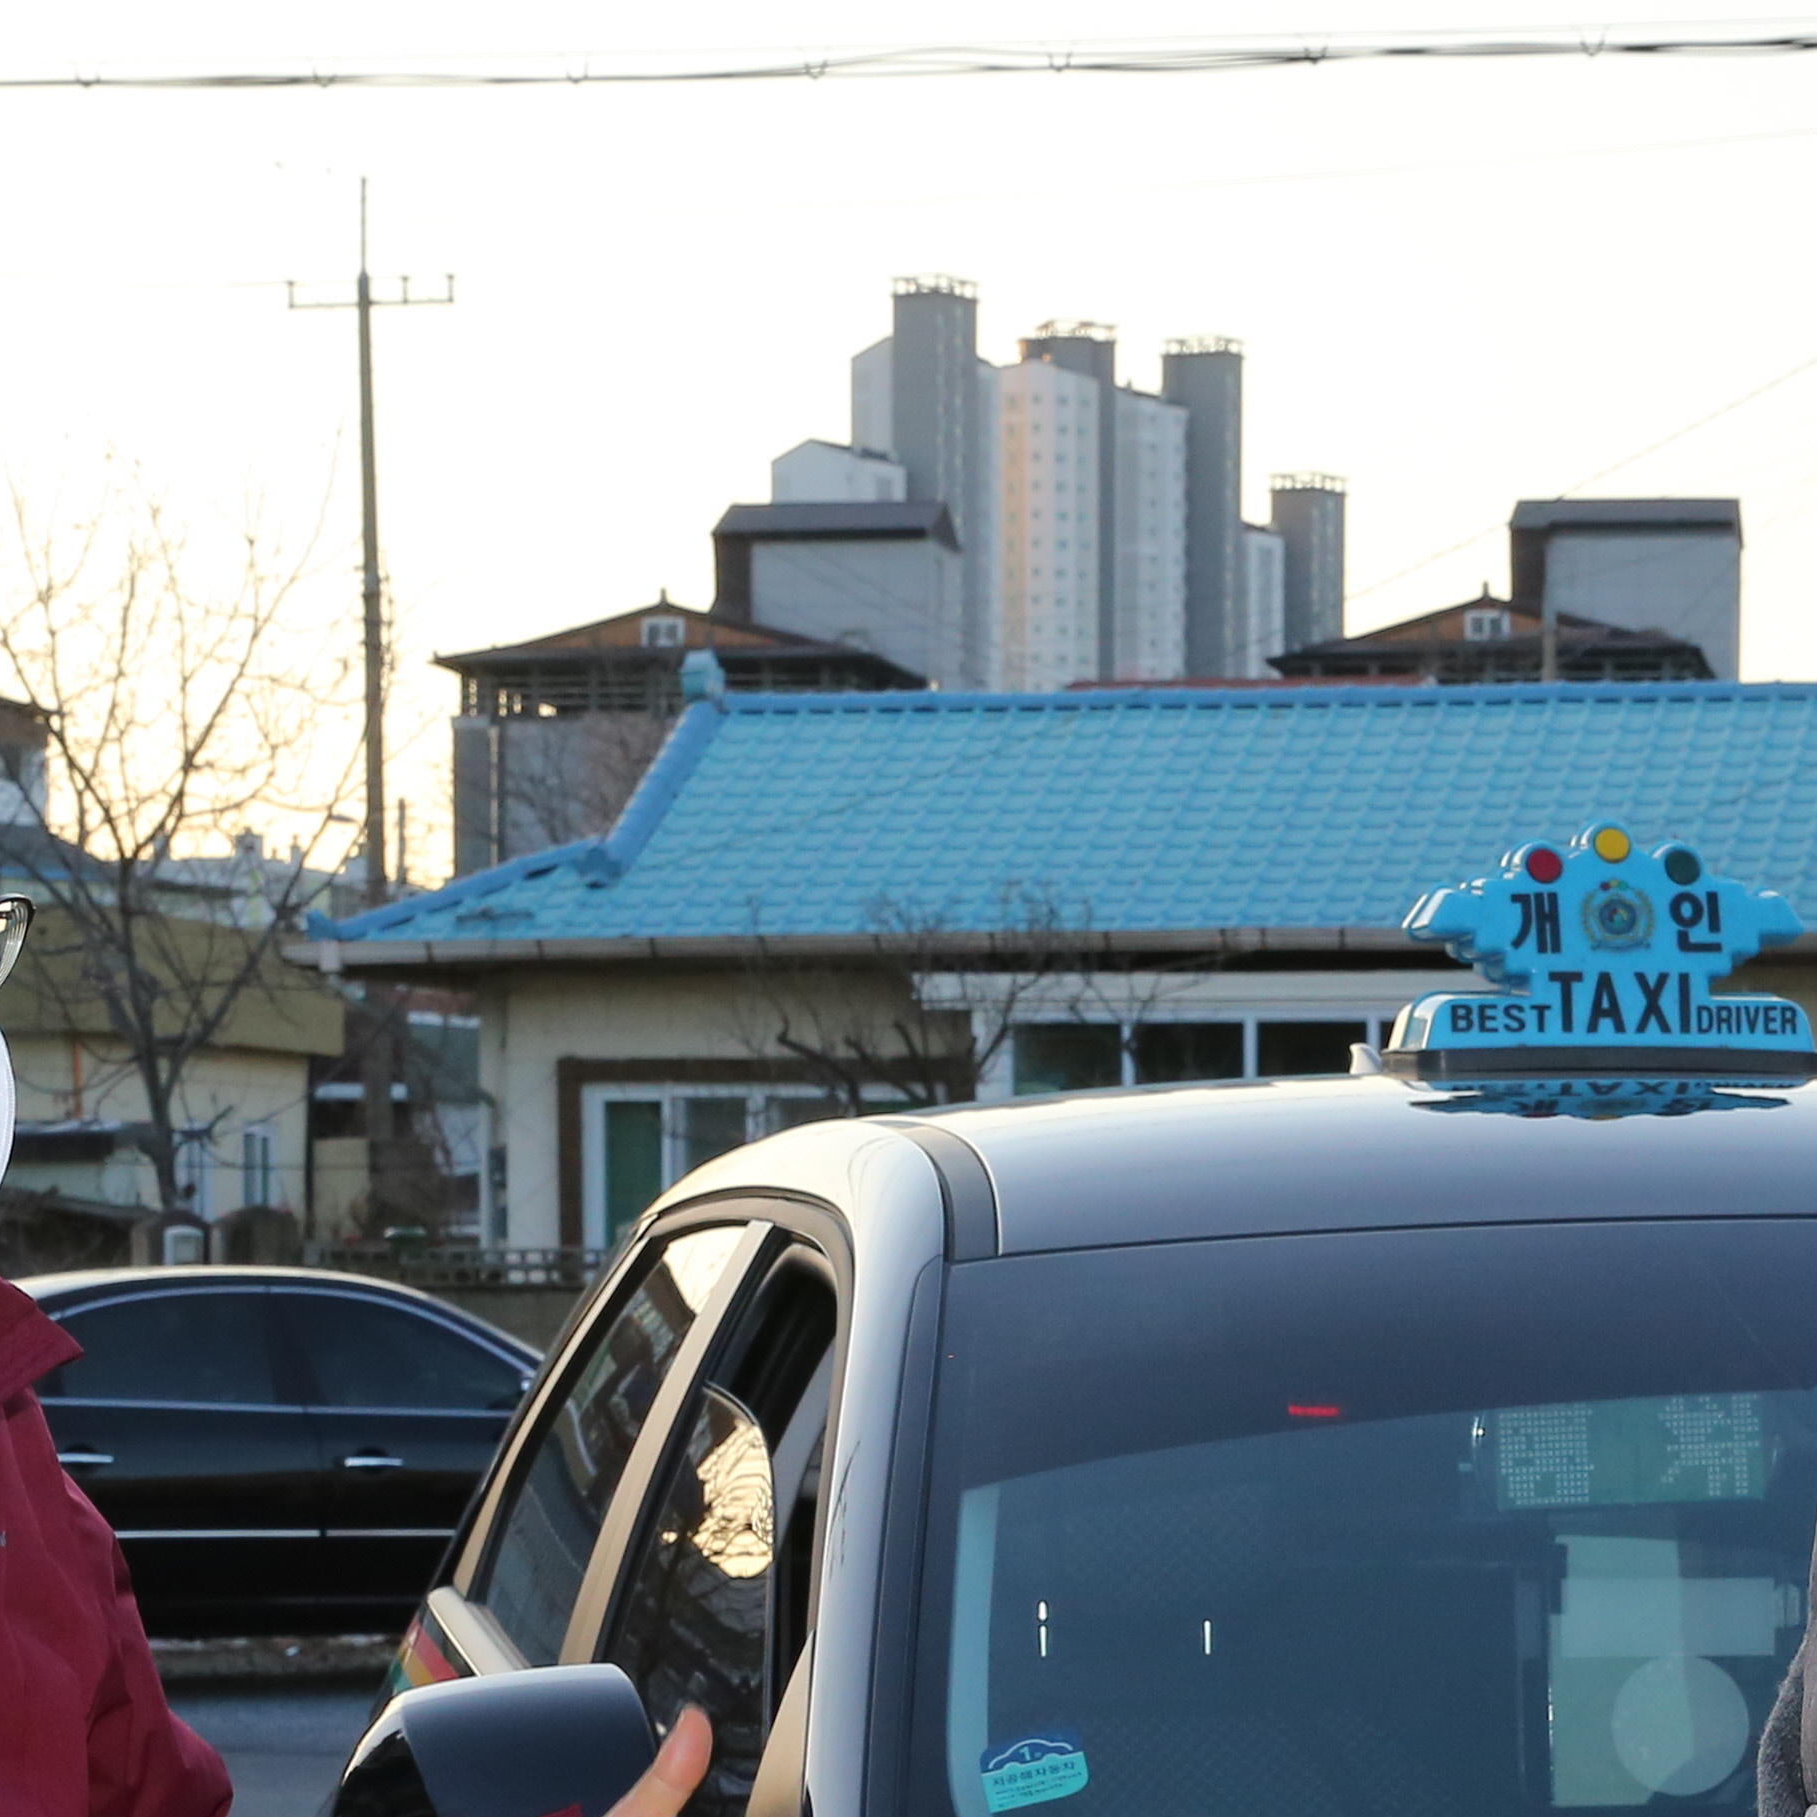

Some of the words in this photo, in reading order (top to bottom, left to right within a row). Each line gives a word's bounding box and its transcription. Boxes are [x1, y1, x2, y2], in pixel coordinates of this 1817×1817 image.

[1449, 1004, 1552, 1034] BEST
[1549, 971, 1691, 1035] TAXI
[1697, 1005, 1798, 1036] DRIVER
